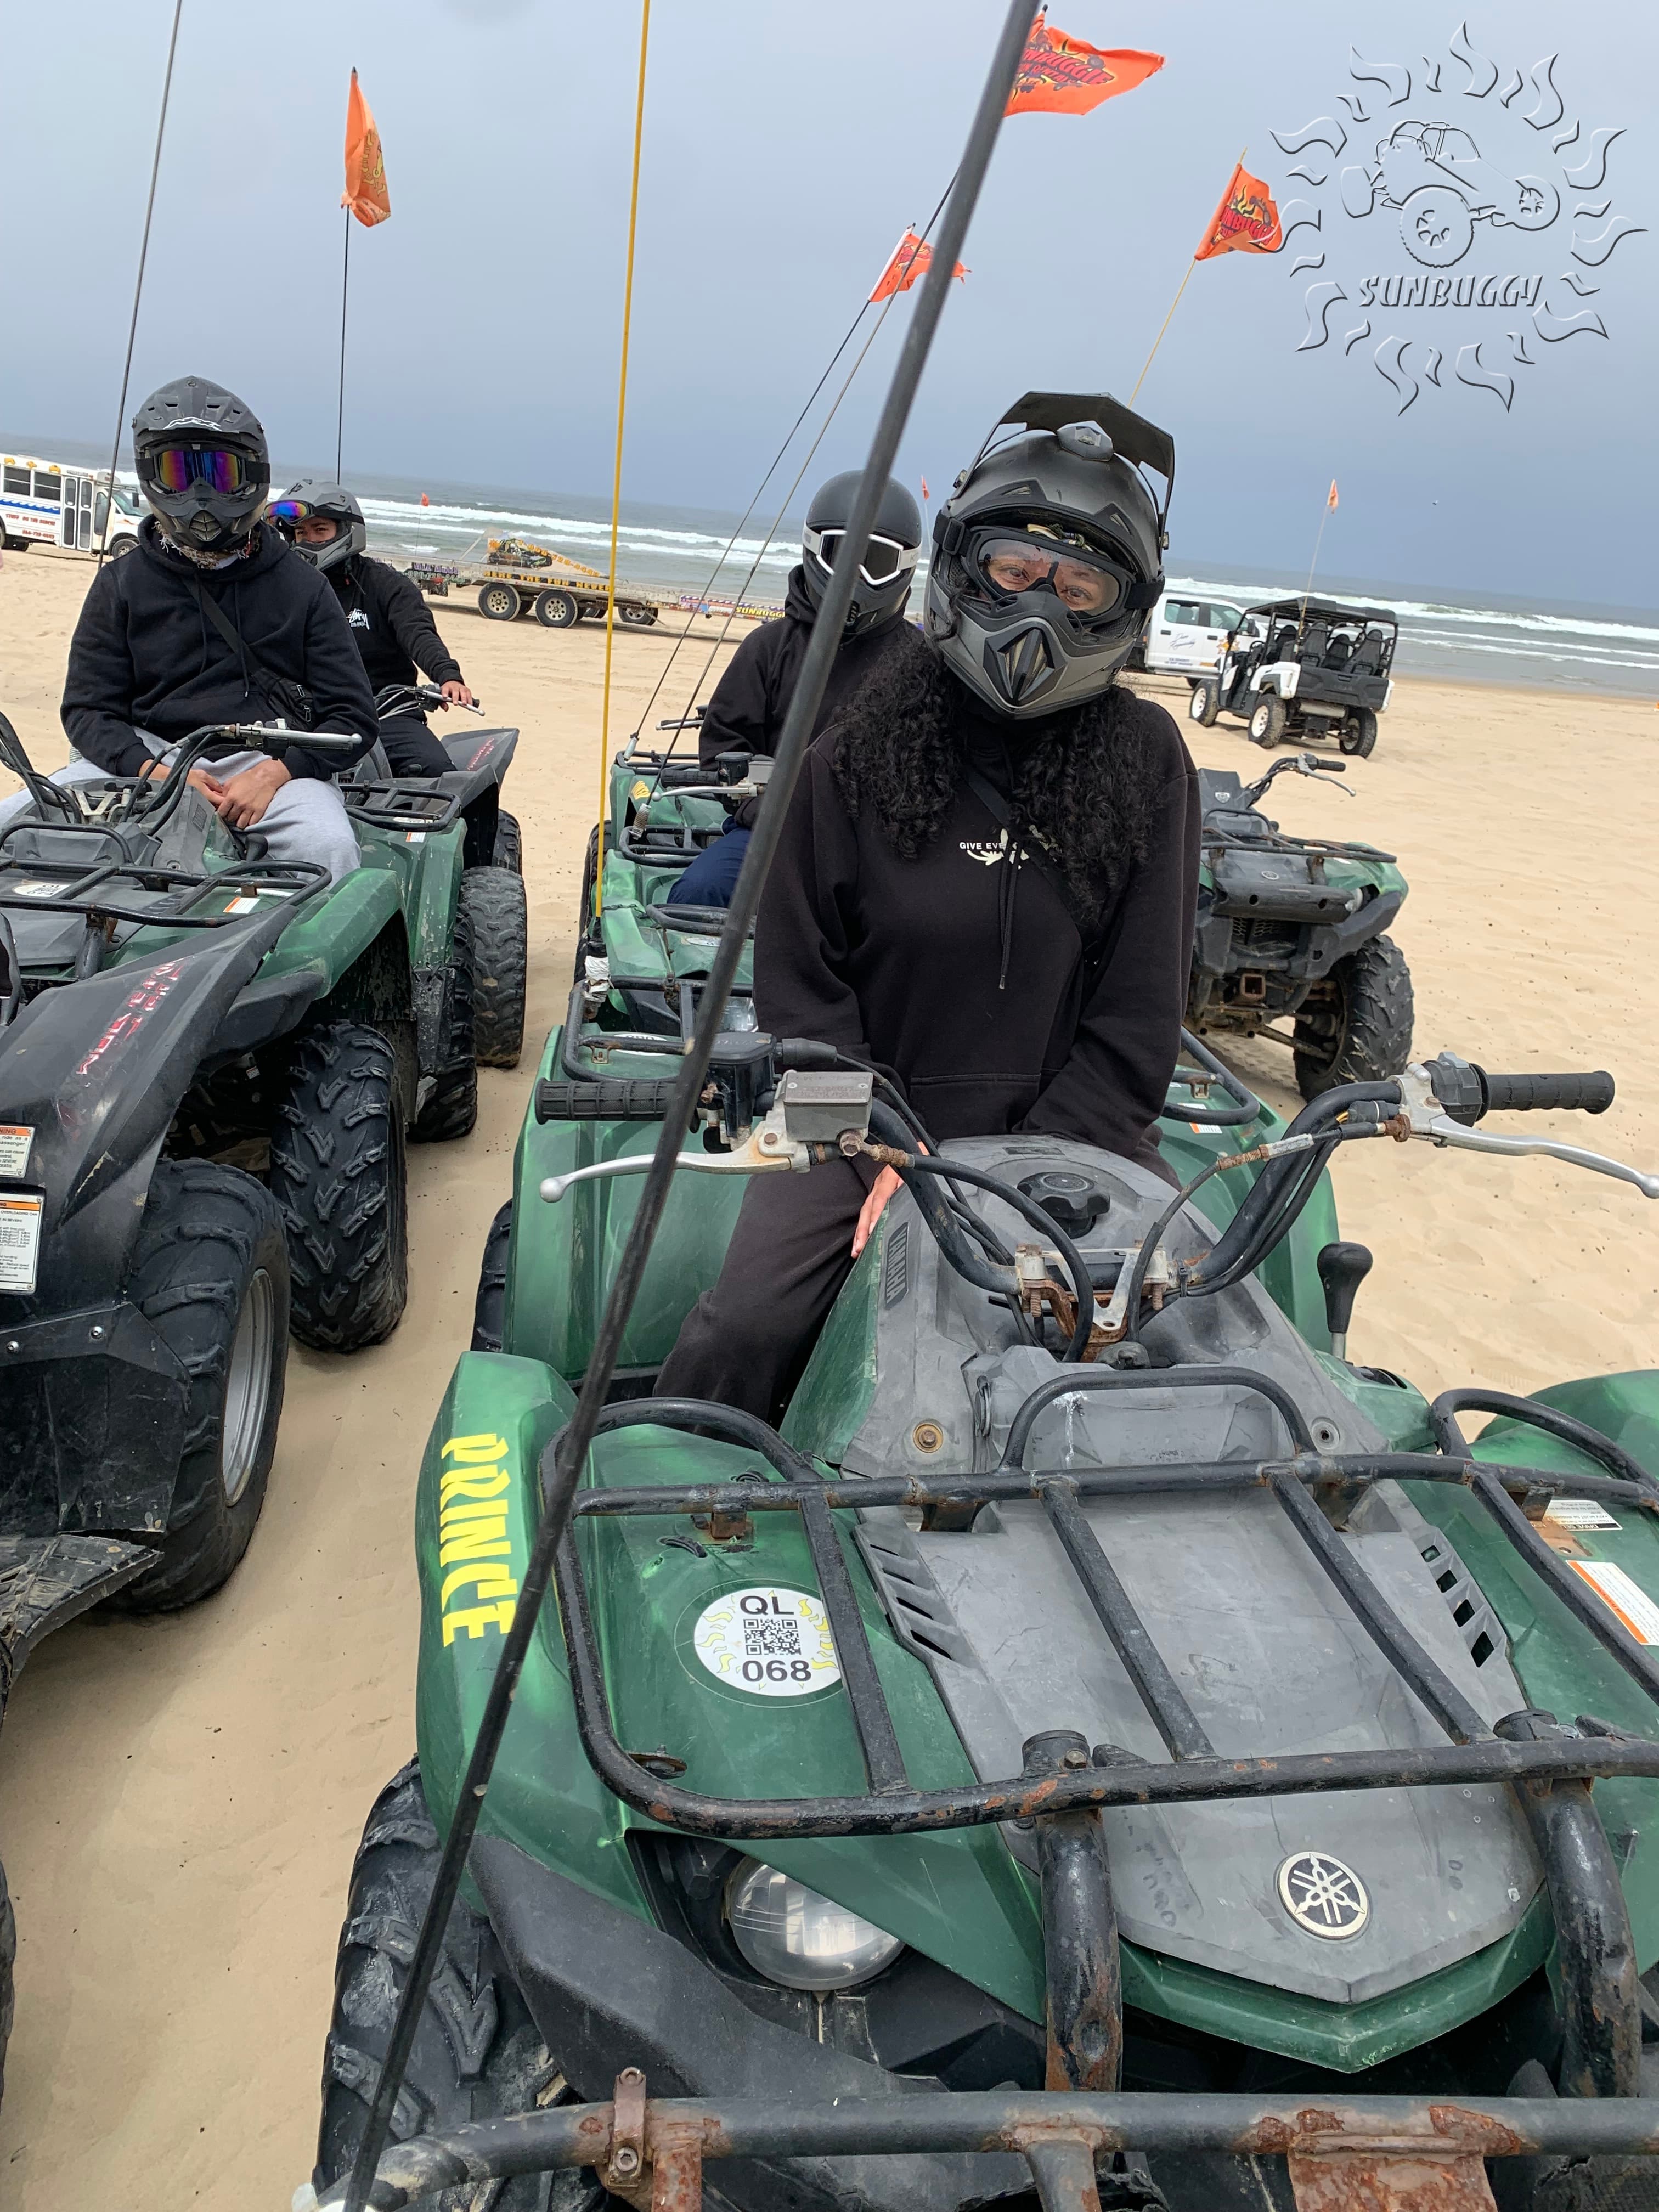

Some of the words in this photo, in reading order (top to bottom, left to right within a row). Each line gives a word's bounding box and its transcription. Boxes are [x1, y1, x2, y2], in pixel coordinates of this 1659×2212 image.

[960, 842, 983, 850] GIVE
[886, 1226, 907, 1305] YAMAHA
[440, 1433, 518, 1647] PRINCE
[740, 1595, 795, 1616] QL
[742, 1660, 812, 1683] 068
